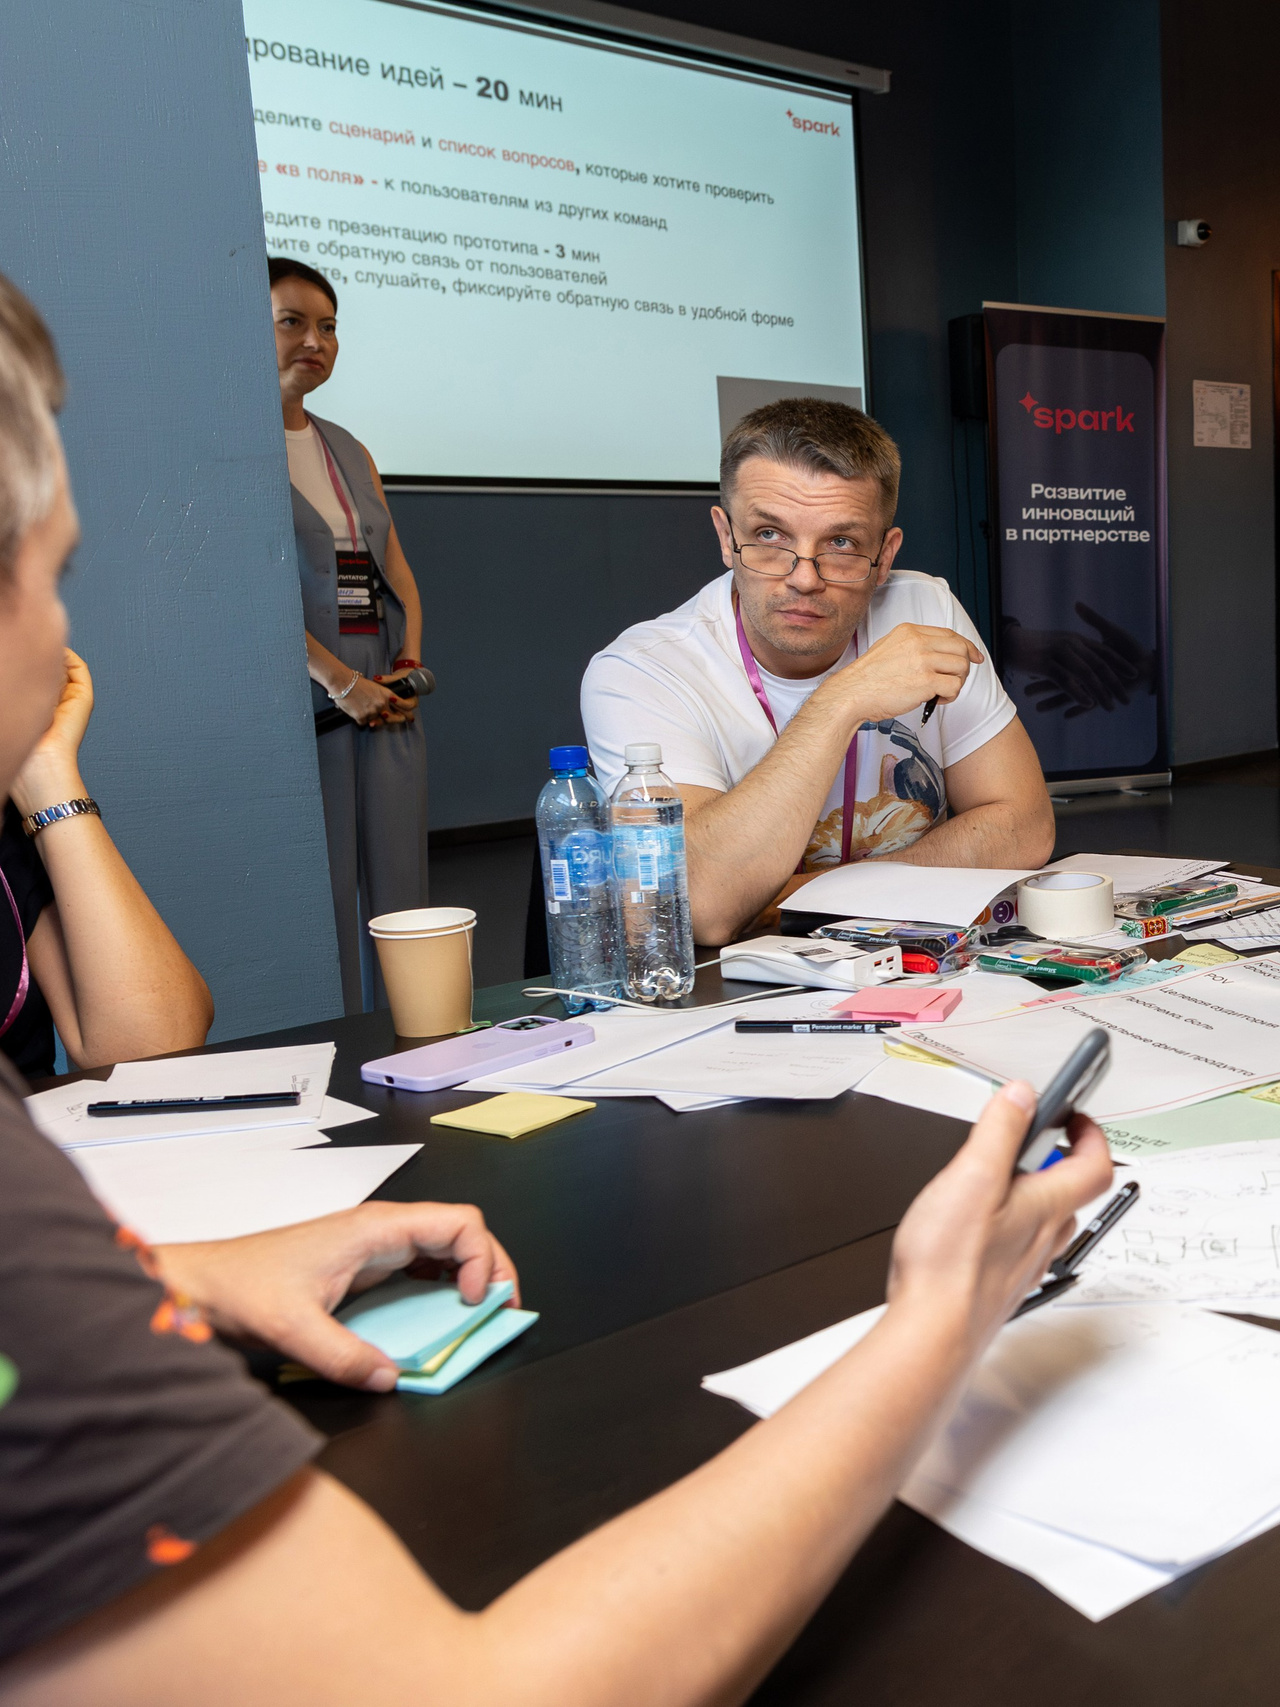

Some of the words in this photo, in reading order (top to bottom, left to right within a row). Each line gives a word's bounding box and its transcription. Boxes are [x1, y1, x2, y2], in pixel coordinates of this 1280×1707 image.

[380, 61, 445, 90] идей
[476, 76, 510, 102] 20
[519, 89, 563, 112] мин
[792, 115, 841, 137] spark
[329, 119, 415, 147] сценарий
[422, 136, 432, 148] и
[438, 137, 496, 159] список
[502, 148, 581, 175] вопросов,
[585, 162, 648, 185] которые
[652, 173, 700, 192] хотите
[705, 181, 775, 205] проверить
[275, 161, 300, 177] «в
[306, 167, 365, 186] поля»
[384, 177, 394, 190] к
[401, 178, 529, 211] пользователям
[535, 199, 553, 212] из
[558, 202, 609, 221] других
[614, 211, 668, 230] команд
[328, 218, 447, 245] презентацию
[453, 233, 538, 255] прототипа
[555, 243, 565, 258] 3
[571, 249, 600, 263] мин
[317, 241, 406, 265] обратную
[411, 250, 460, 269] связь
[465, 258, 483, 272] от
[490, 261, 607, 285] пользователей
[354, 269, 447, 294] слушайте,
[452, 278, 551, 302] фиксируйте
[557, 290, 629, 312] обратную
[634, 299, 674, 315] связь
[679, 304, 686, 315] в
[691, 305, 747, 322] удобной
[751, 310, 794, 328] форме
[1033, 404, 1135, 434] spark
[1030, 483, 1127, 501] Развитие
[1021, 503, 1135, 525] инноваций
[1006, 528, 1018, 541] в
[1022, 528, 1151, 544] партнерстве
[1203, 972, 1235, 985] POV
[1159, 986, 1210, 1007] Целевая
[1210, 1004, 1280, 1029] аудитория
[1184, 1017, 1214, 1031] боль
[1061, 1005, 1153, 1043] Отличительные
[1152, 1041, 1188, 1057] фичи
[1189, 1053, 1255, 1077] продукта
